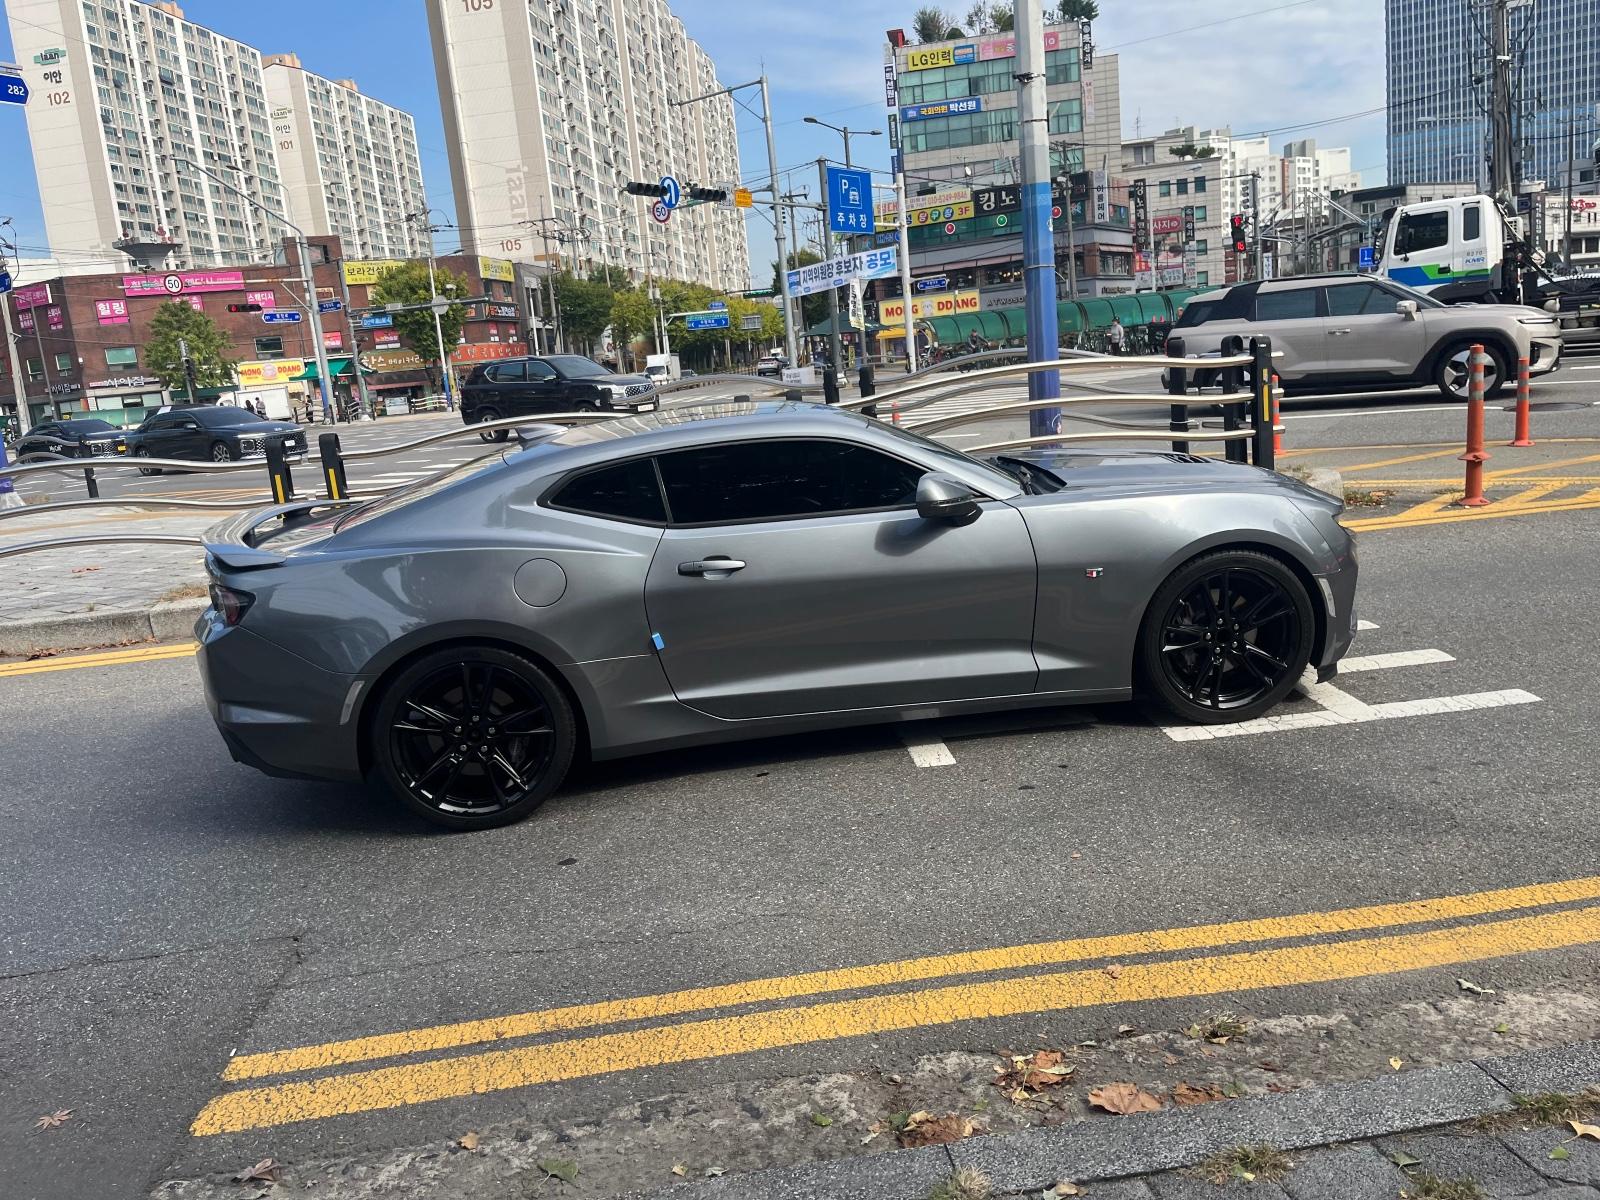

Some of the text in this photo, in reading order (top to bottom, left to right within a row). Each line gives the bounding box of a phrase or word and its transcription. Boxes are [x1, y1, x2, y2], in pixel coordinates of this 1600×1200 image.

[911, 49, 951, 67] LG인력
[43, 69, 62, 84] 이안
[7, 84, 25, 96] 282
[47, 91, 70, 106] 102
[920, 100, 977, 115] 국회의원 박선원
[275, 124, 290, 133] 이안
[279, 140, 293, 150] 101
[841, 179, 849, 194] P
[655, 206, 667, 217] 50
[957, 206, 970, 216] 3F
[837, 212, 867, 228] 주차장
[500, 239, 522, 252] 105
[347, 266, 399, 276] 보라건설인
[802, 262, 834, 284] 지역위원장
[835, 255, 863, 275] 후보자
[866, 250, 893, 269] 공모
[167, 279, 180, 289] 50
[97, 302, 125, 315] 힐링
[885, 297, 977, 318] MOG DDANG
